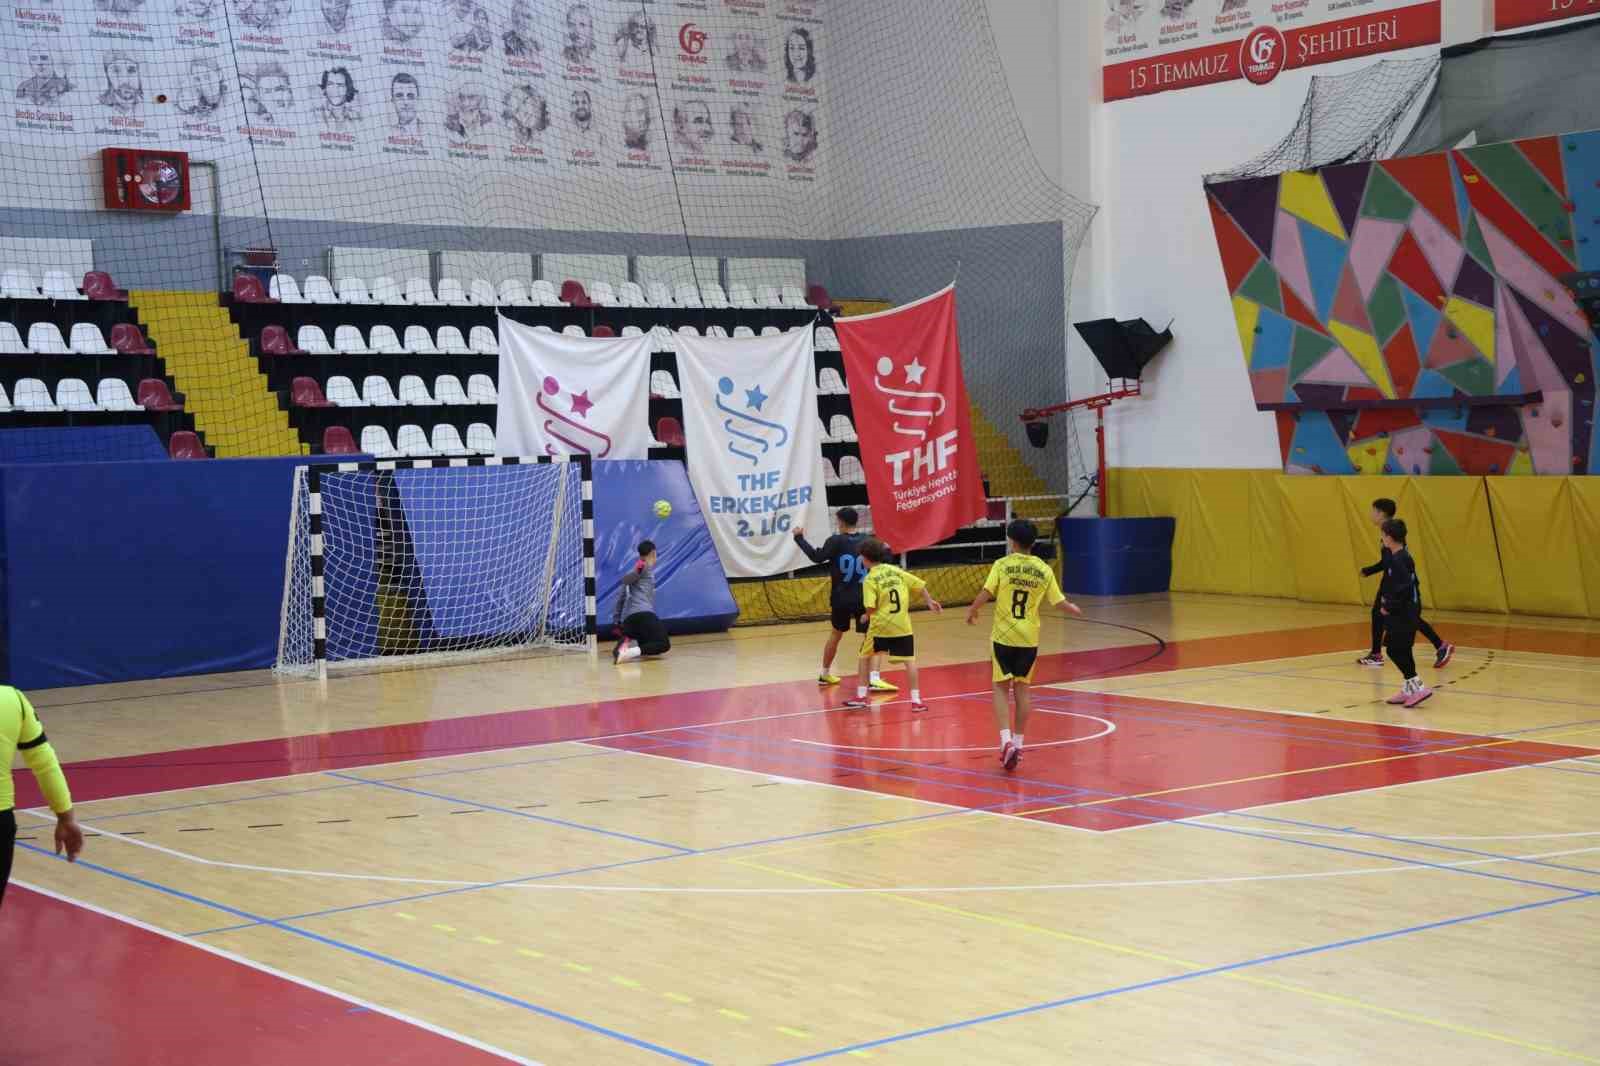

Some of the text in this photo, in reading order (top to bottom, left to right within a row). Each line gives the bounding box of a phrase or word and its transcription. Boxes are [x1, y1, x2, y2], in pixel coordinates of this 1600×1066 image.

[1129, 15, 1398, 90] 15 TEMMUZ ŞEHİTLERİ
[885, 430, 958, 486] THF
[737, 470, 781, 491] THF
[893, 484, 927, 501] Türkiye
[710, 485, 812, 514] ERKEKLER
[737, 511, 791, 537] 2. LİG
[889, 588, 901, 614] 9
[1011, 589, 1030, 620] 8
